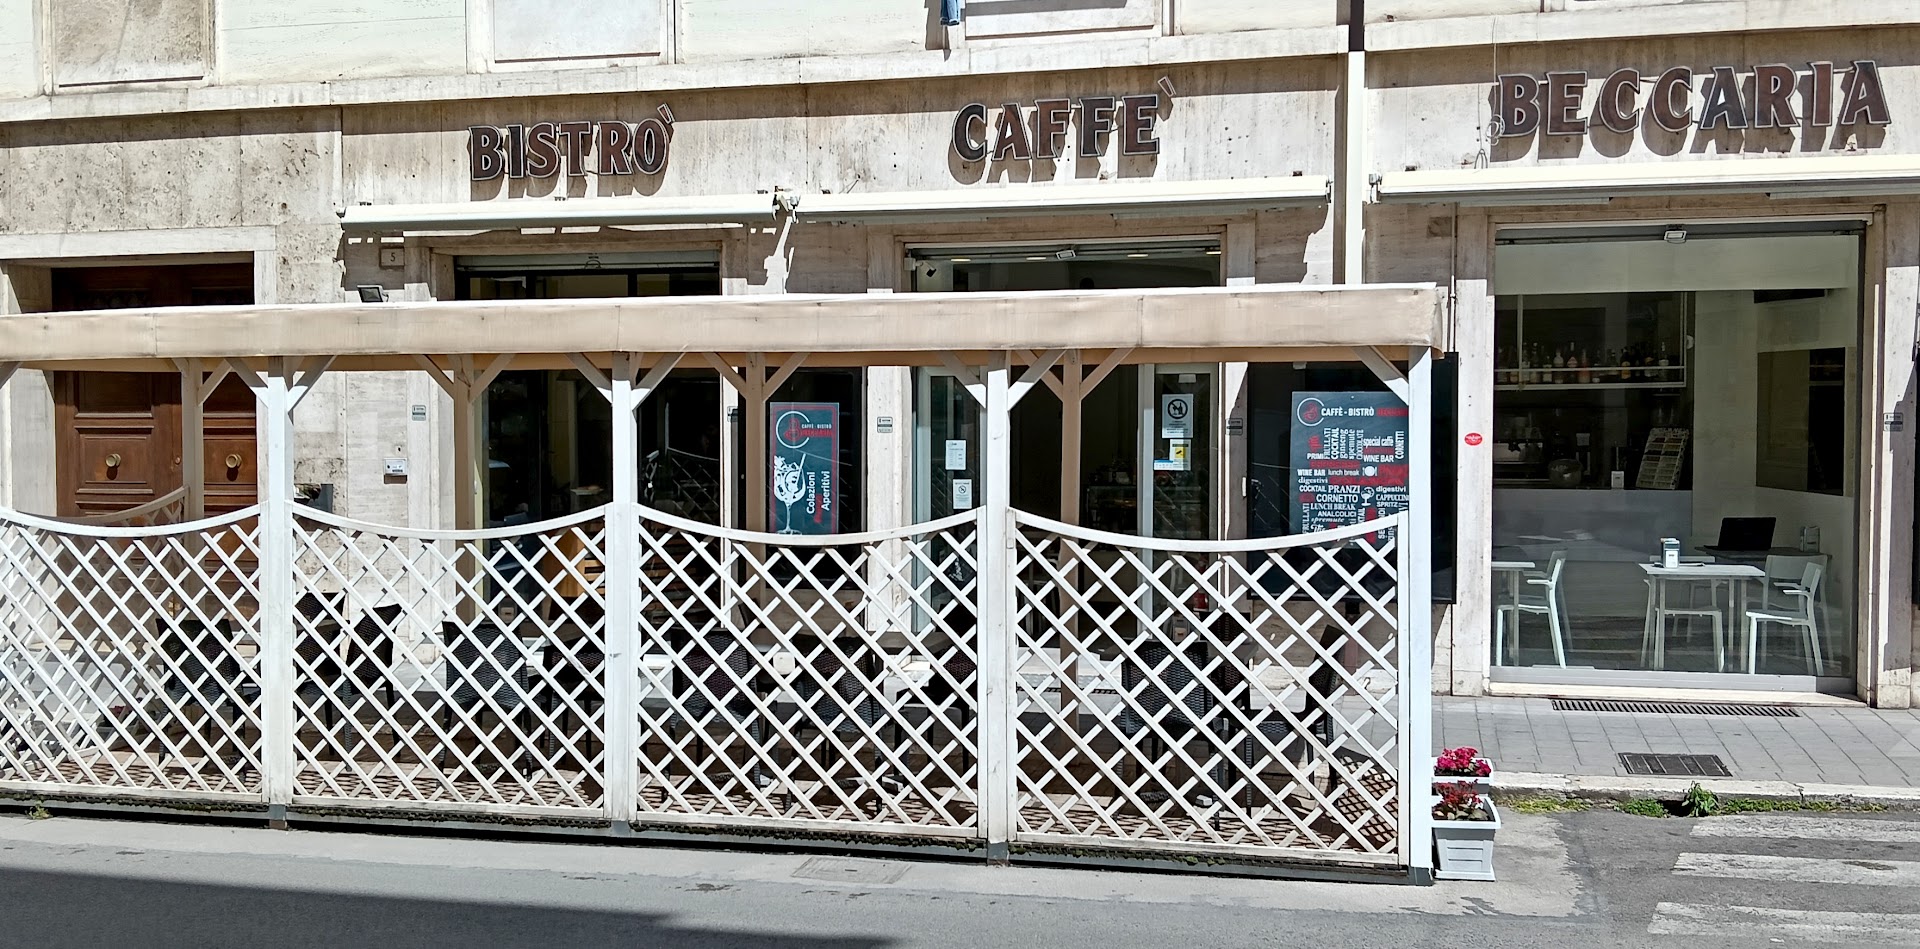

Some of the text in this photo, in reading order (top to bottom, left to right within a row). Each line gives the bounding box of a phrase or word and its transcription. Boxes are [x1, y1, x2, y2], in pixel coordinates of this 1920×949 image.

[1497, 60, 1891, 137] BECCARIA
[390, 252, 396, 263] 5
[1321, 406, 1343, 417] CAFFÈ
[1348, 406, 1375, 417] BISTRÒ
[1331, 428, 1339, 459] COCKTAIL
[1340, 429, 1349, 459] ginseng
[1363, 436, 1381, 449] special
[1395, 431, 1404, 459] CORNETTI
[1363, 455, 1394, 463] WINE BAR
[1298, 477, 1328, 485] digestivi
[806, 471, 816, 514] Colazioni
[821, 470, 830, 511] Aperitivi
[1299, 485, 1360, 493] COCKTAIL PRANZI
[1316, 494, 1359, 503] CORNETTO
